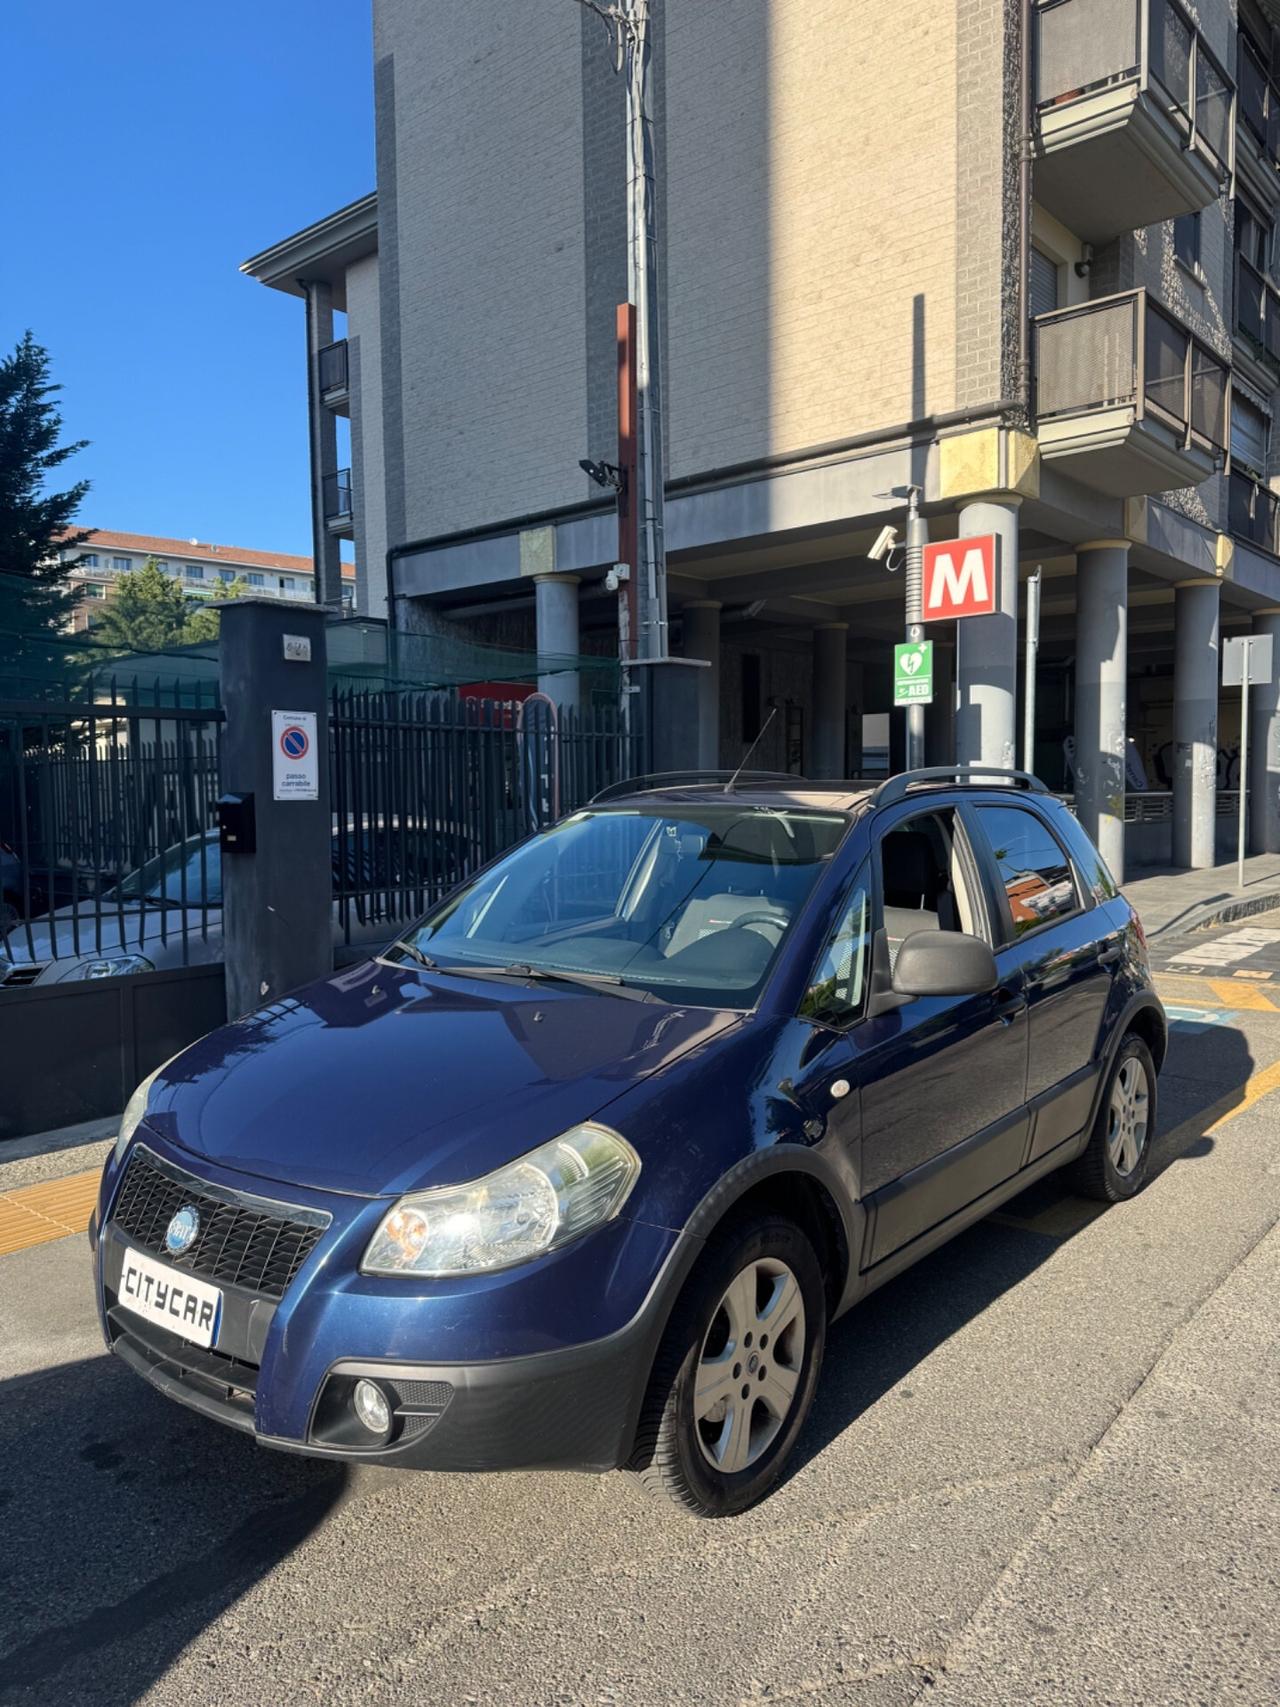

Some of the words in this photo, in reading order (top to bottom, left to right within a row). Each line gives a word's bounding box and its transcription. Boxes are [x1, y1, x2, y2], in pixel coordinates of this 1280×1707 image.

[928, 548, 989, 609] M
[908, 684, 929, 696] AED
[125, 1266, 214, 1331] CITYCAR
